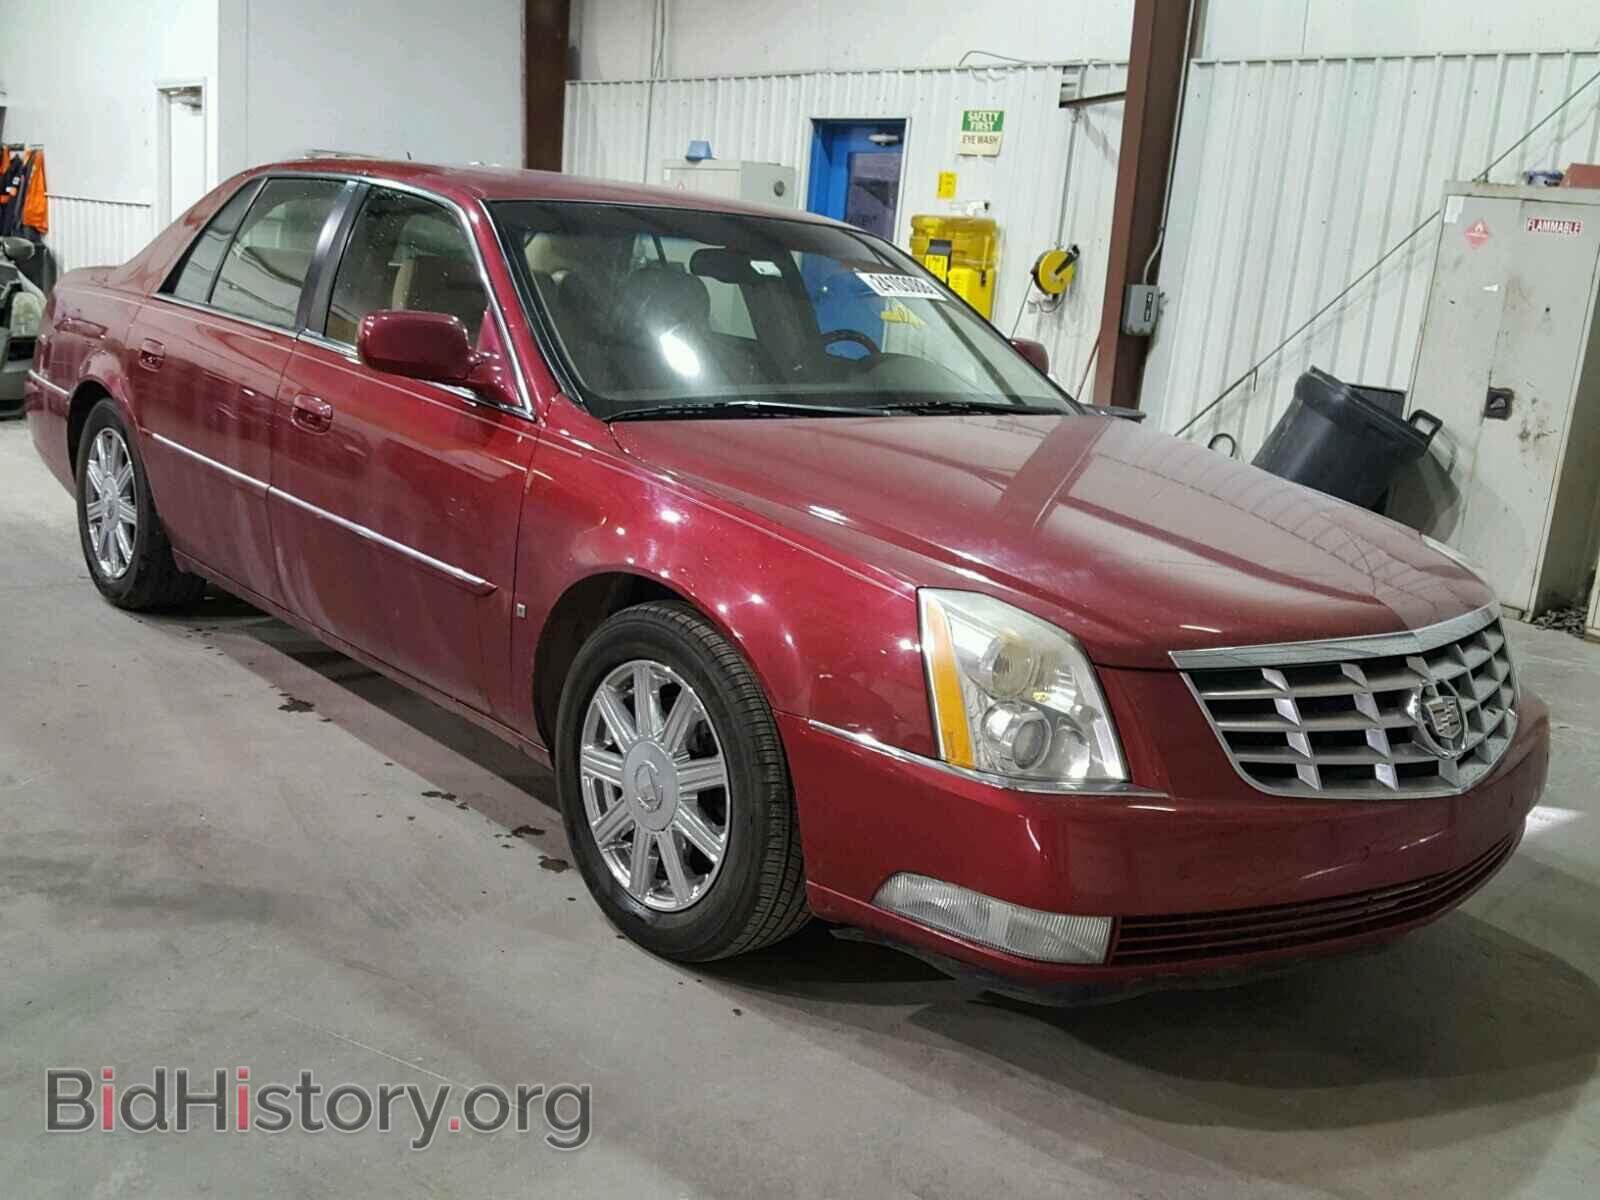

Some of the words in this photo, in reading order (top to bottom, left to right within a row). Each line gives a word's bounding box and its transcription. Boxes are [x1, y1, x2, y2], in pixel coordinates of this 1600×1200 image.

[967, 111, 1001, 122] SAFETY
[969, 121, 994, 132] FIRST
[961, 134, 976, 145] EYE
[977, 134, 1000, 145] WASH
[1527, 217, 1581, 233] FLAMMABLE
